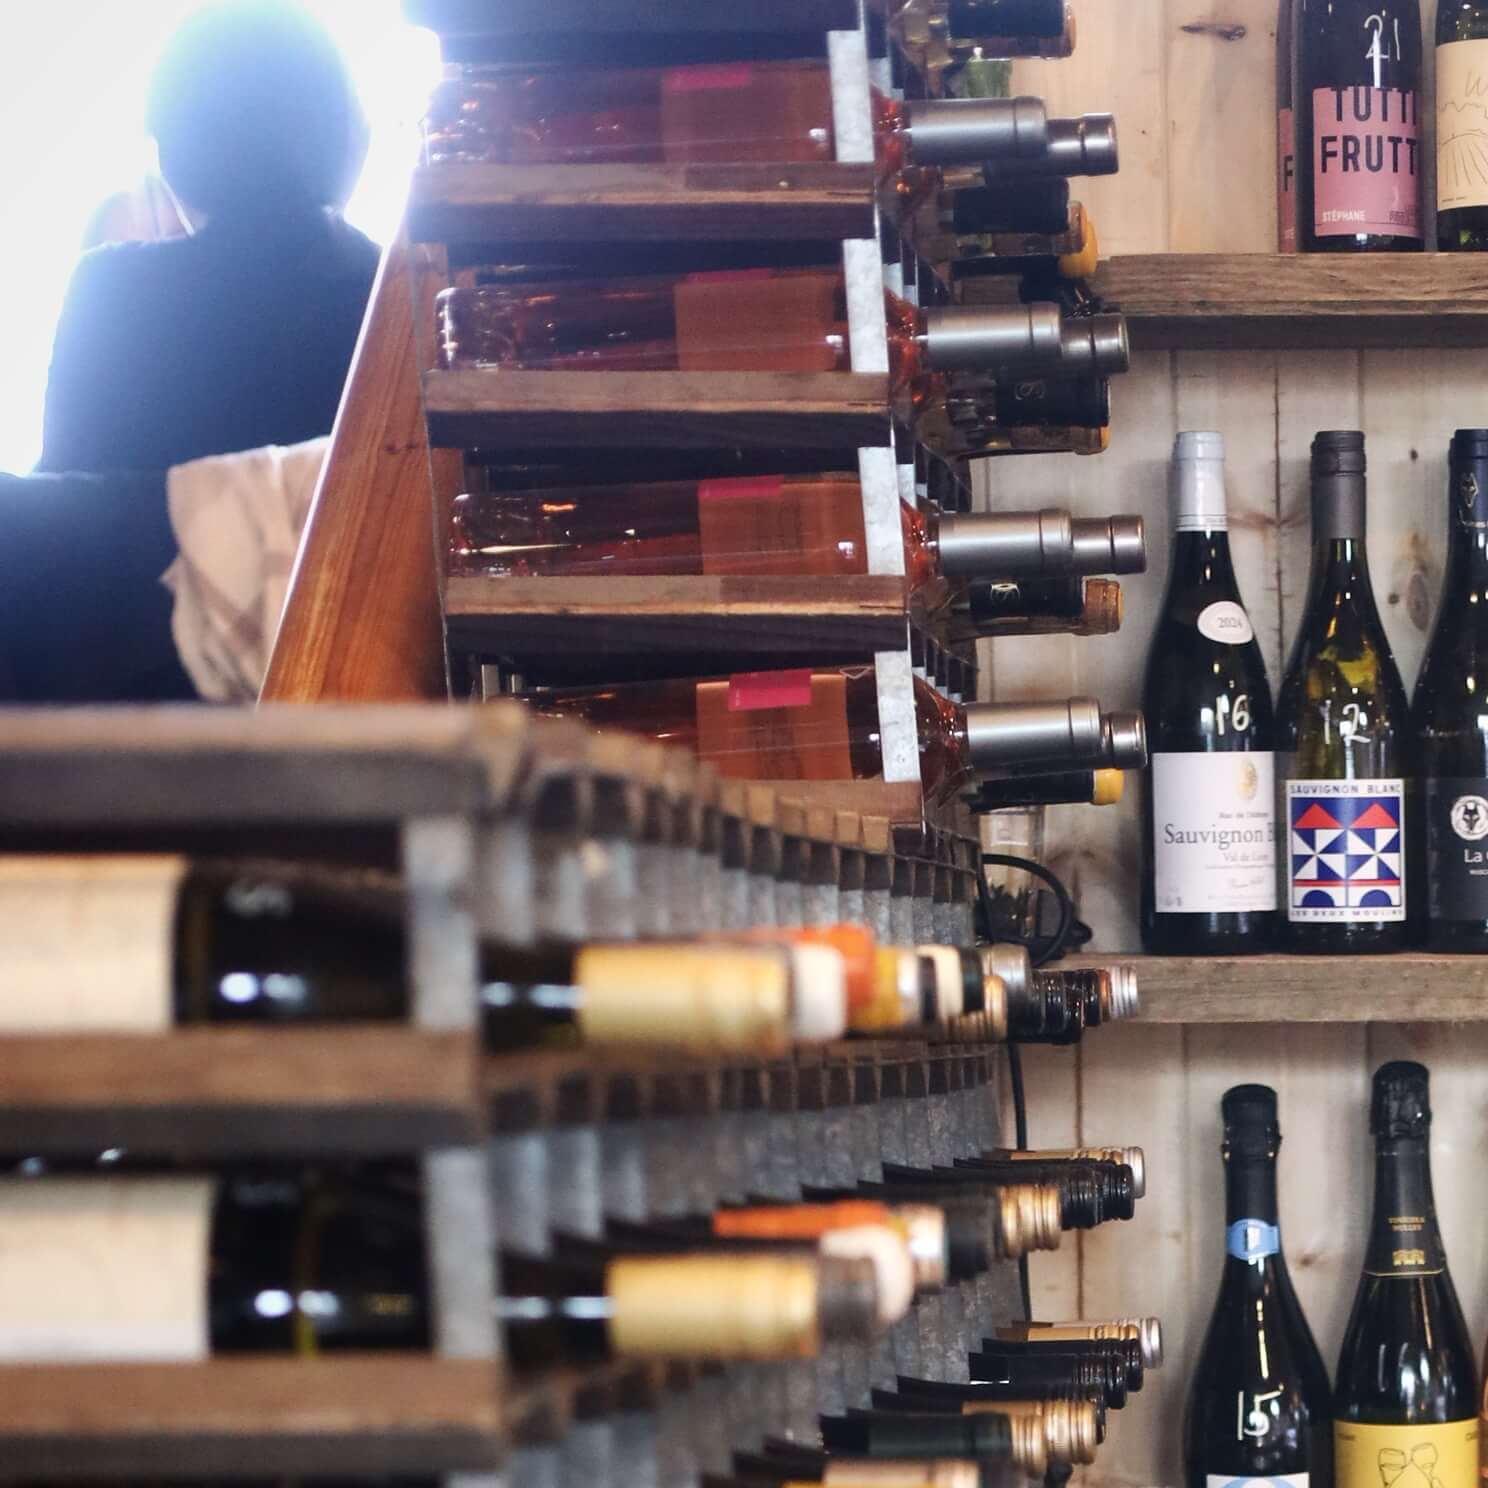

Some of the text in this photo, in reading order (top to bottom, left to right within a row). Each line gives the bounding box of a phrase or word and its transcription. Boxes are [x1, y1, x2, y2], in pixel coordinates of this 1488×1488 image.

[1290, 783, 1359, 795] SAUVIGNON
[1163, 822, 1263, 851] Sauvignon
[1463, 847, 1483, 863] La
